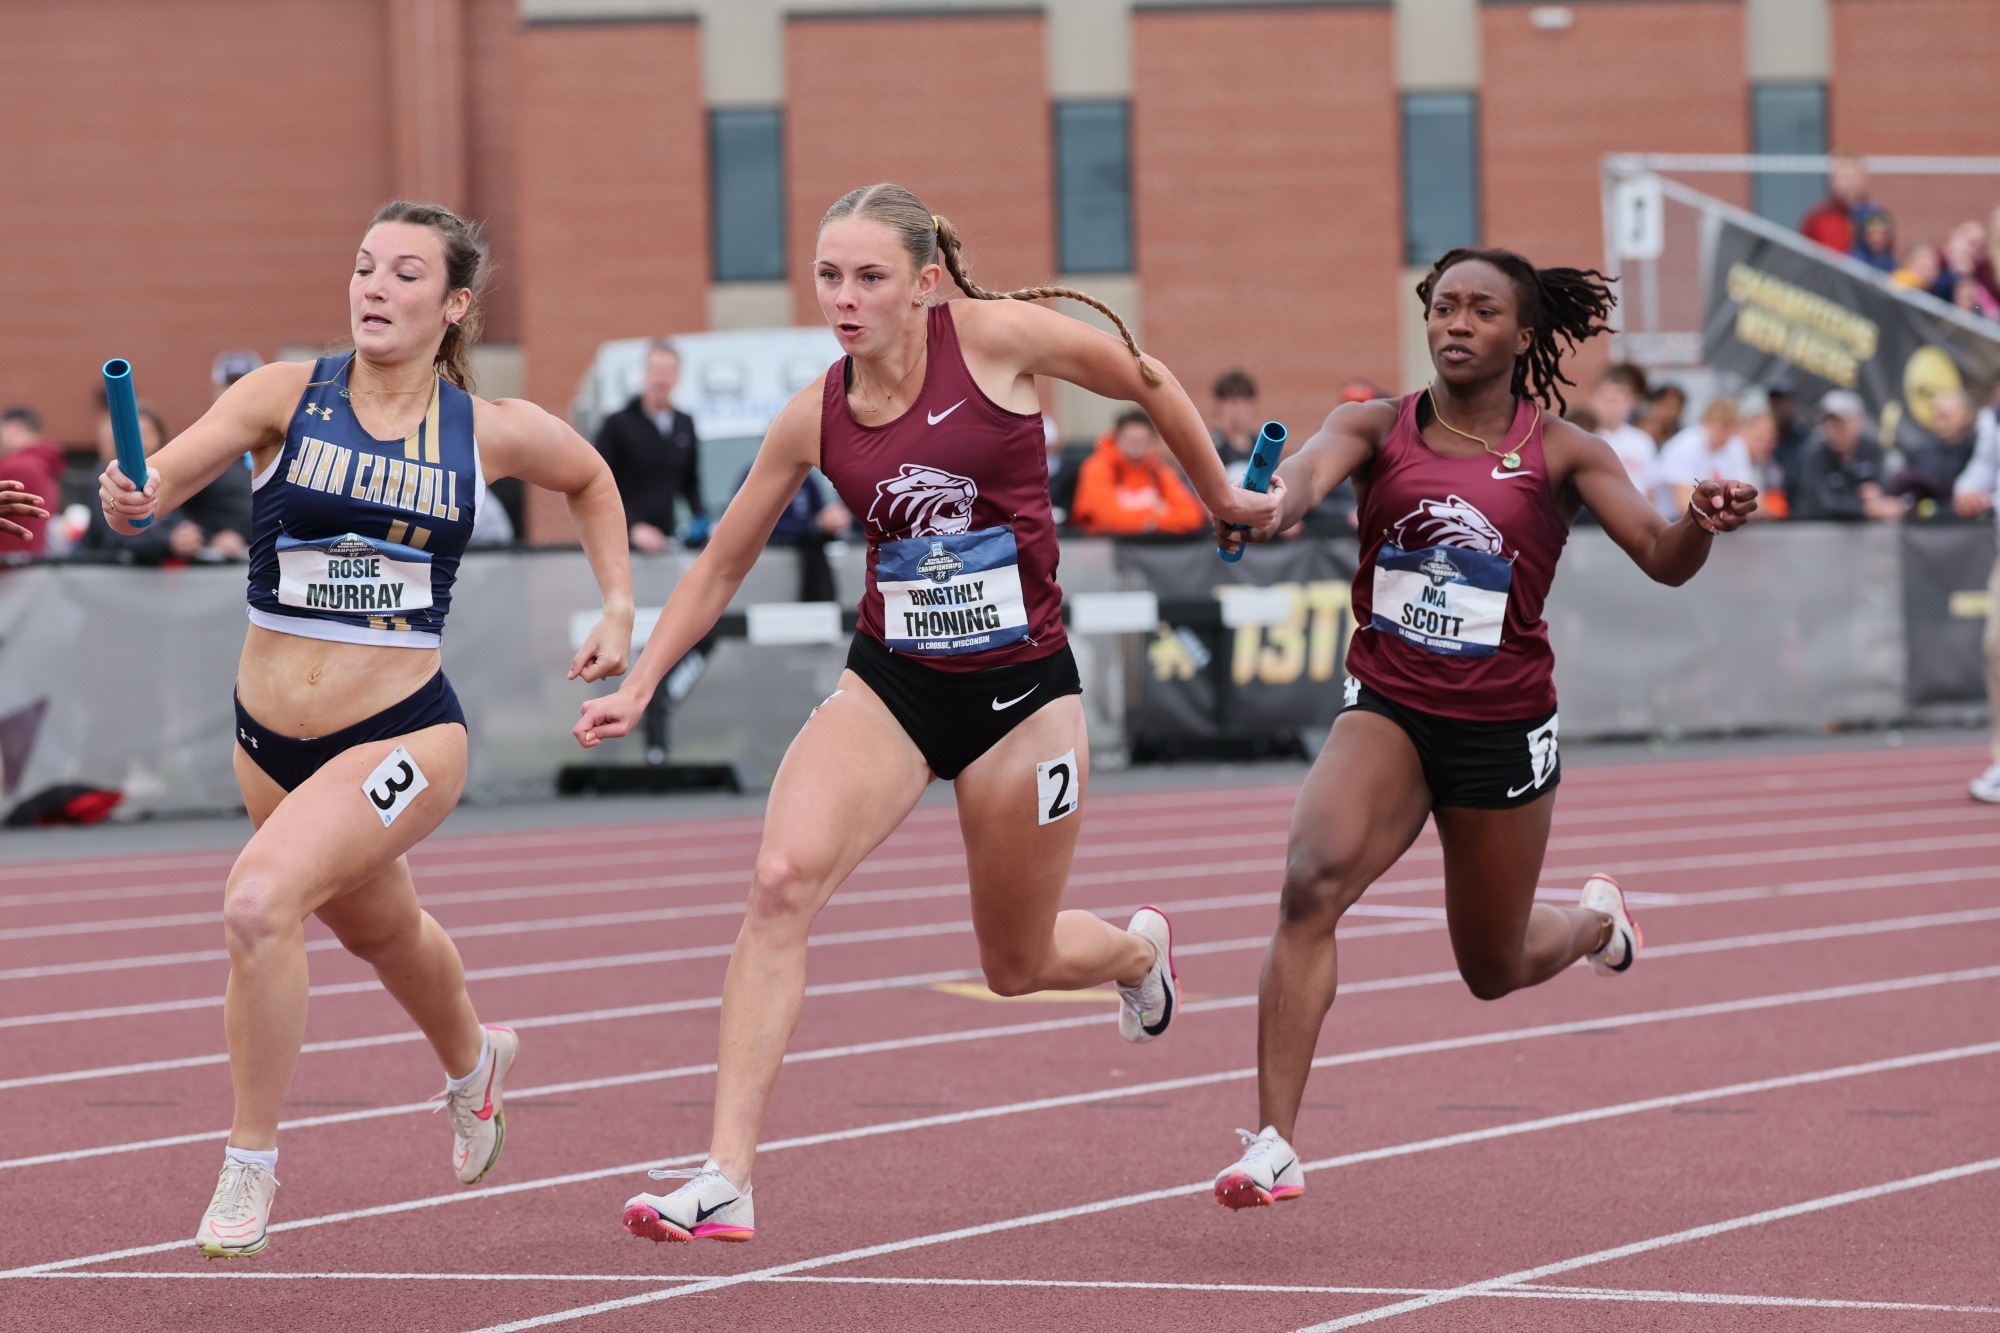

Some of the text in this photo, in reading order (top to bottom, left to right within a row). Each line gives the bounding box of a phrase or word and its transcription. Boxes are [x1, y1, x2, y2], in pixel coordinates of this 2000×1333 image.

[286, 436, 460, 521] JOHN CARROLL
[328, 559, 380, 578] ROSIE
[306, 583, 404, 609] MURRAY
[908, 581, 984, 606] BRIGTHLY
[1421, 585, 1446, 608] NIA
[904, 604, 1001, 637] THONING
[1401, 602, 1464, 637] SCOTT
[918, 635, 990, 650] LA CROSSE, WISCONSIN
[1427, 638, 1463, 651] WISCONSIN
[370, 760, 414, 810] 3
[1048, 763, 1070, 819] 2
